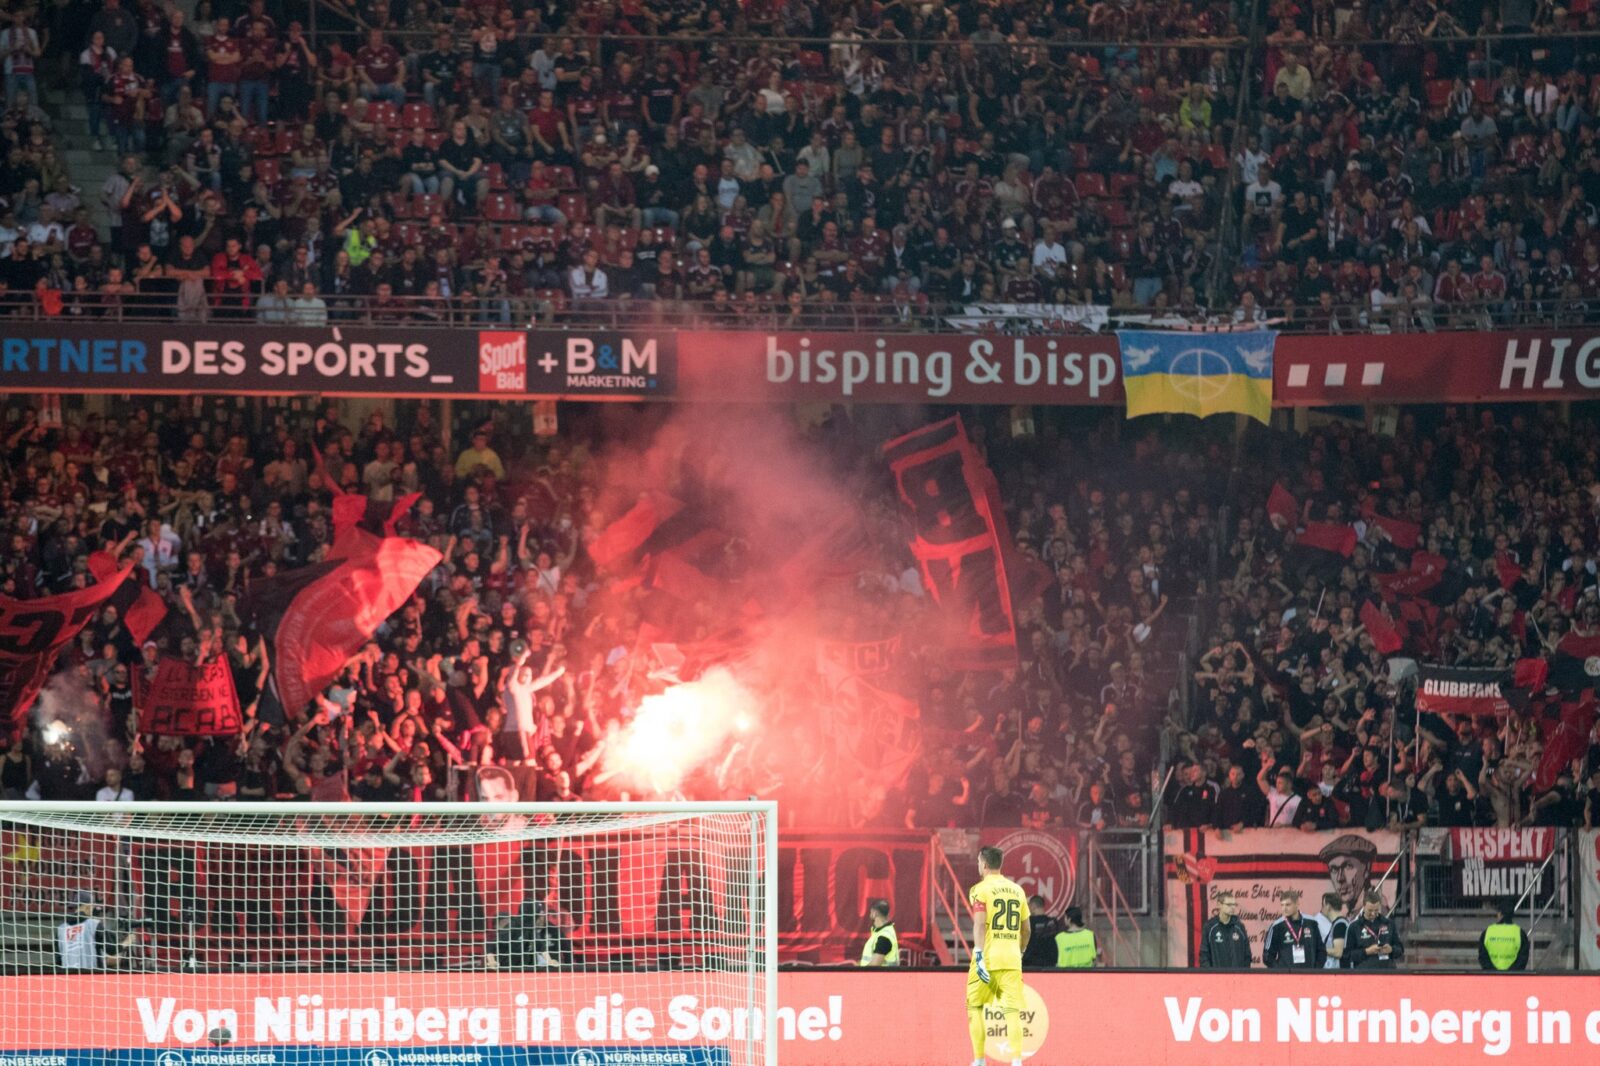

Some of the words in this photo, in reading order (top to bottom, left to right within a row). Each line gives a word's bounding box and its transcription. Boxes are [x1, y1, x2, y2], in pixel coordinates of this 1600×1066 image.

[2, 338, 147, 374] RTNER
[161, 340, 247, 375] DES
[480, 336, 526, 375] Sport
[566, 338, 658, 375] B&M
[766, 336, 952, 397] bisping
[964, 338, 1003, 384] &
[1014, 339, 1117, 397] bisp
[1500, 336, 1600, 390] HIG
[496, 372, 525, 389] Bild
[566, 375, 647, 388] MARKETING
[1424, 678, 1502, 699] GLUBBFANS
[1459, 826, 1548, 860] RESPEKT
[1461, 862, 1544, 897] RIVALITÄT
[991, 898, 1020, 931] 26
[136, 996, 237, 1043] Von
[253, 993, 500, 1047] Nürnberg
[514, 992, 562, 1042] in
[575, 993, 656, 1042] die
[667, 994, 842, 1041] Sonne!
[1163, 996, 1261, 1043] Von
[1276, 995, 1511, 1056] Nürnberg
[1526, 996, 1571, 1044] in
[190, 1053, 276, 1065] NÜRNBERGER
[399, 1052, 483, 1063] NÜRNBERGER
[604, 1052, 688, 1064] NÜRNBERGER
